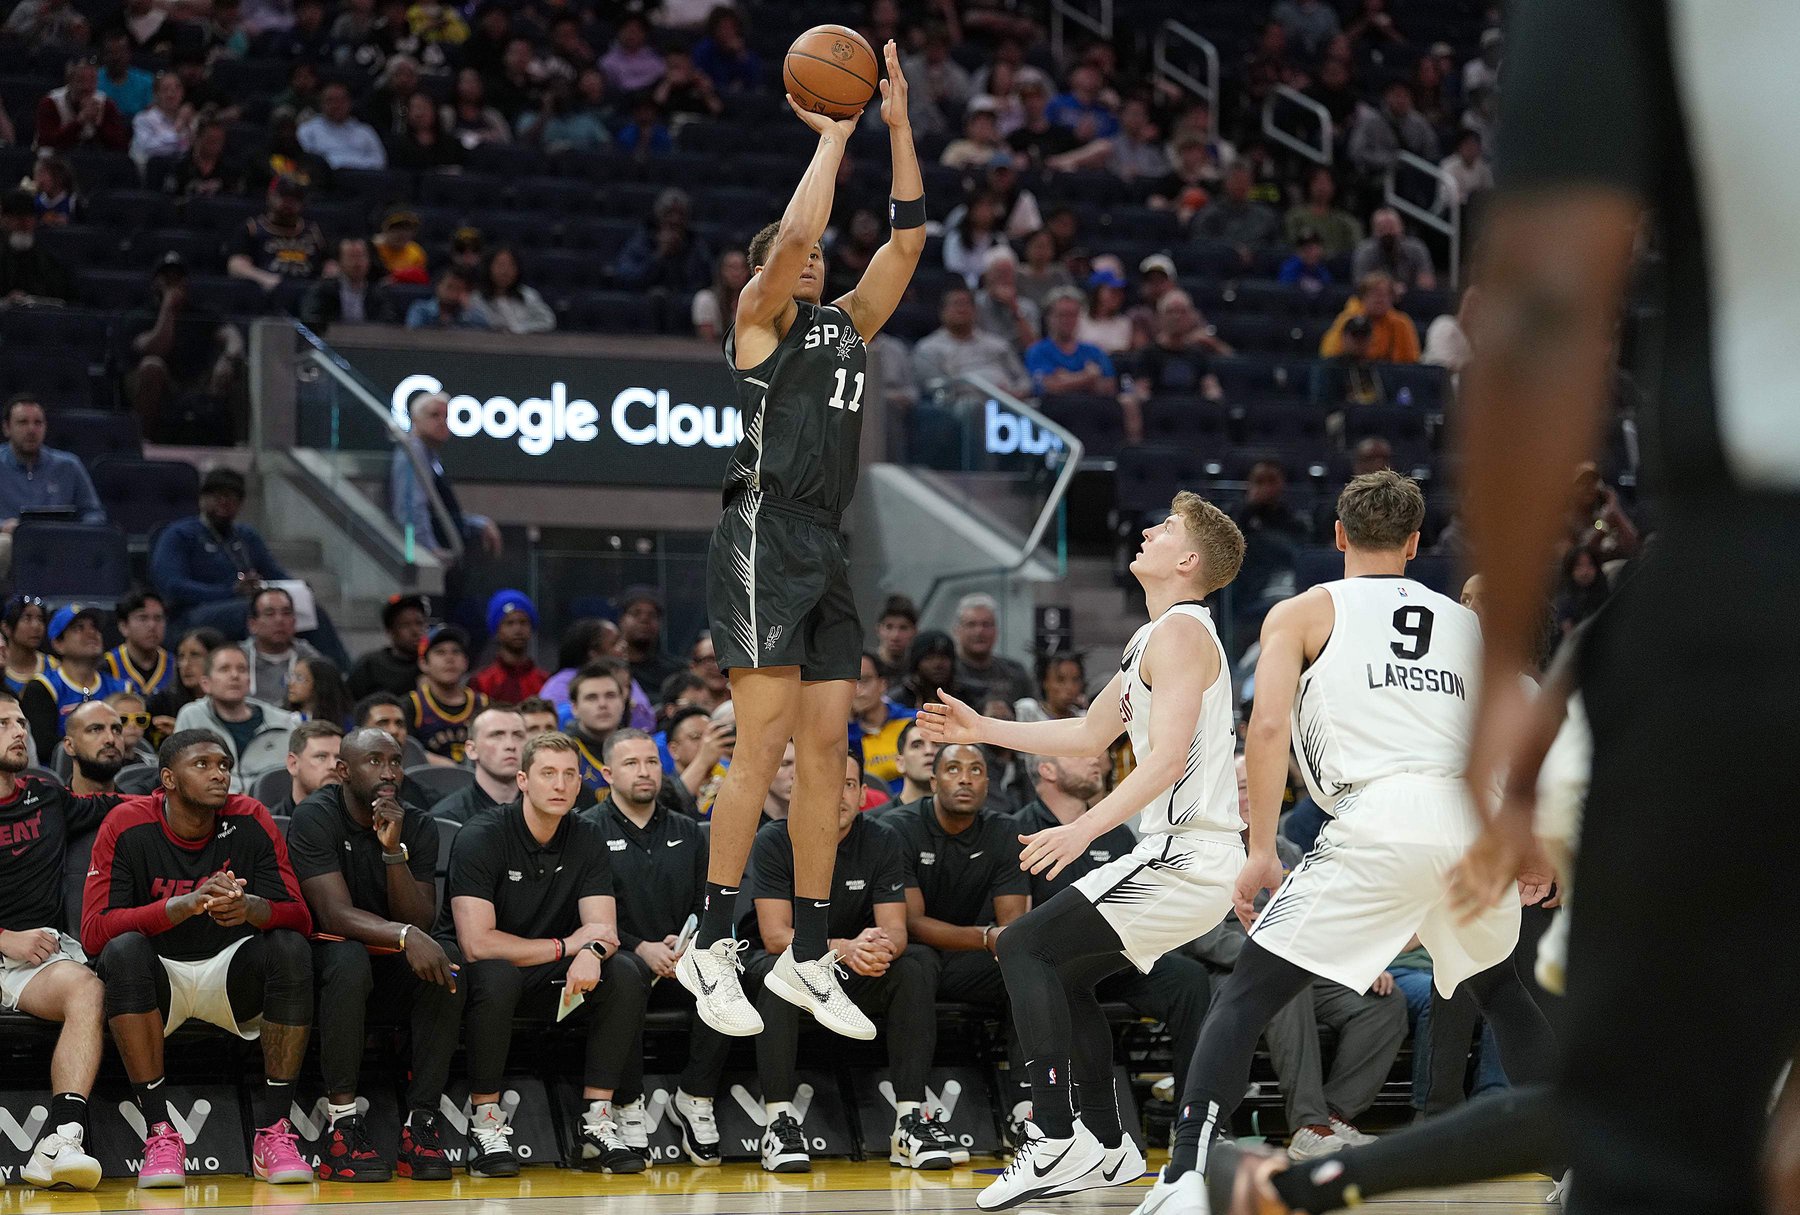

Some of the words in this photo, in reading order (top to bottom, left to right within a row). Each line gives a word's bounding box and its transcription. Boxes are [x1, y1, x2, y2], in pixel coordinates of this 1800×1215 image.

[828, 367, 865, 413] 11
[611, 387, 745, 448] Clou
[985, 399, 1063, 456] bu
[1390, 605, 1434, 661] 9
[1366, 663, 1465, 701] LARSSON
[125, 1156, 220, 1173] WMO
